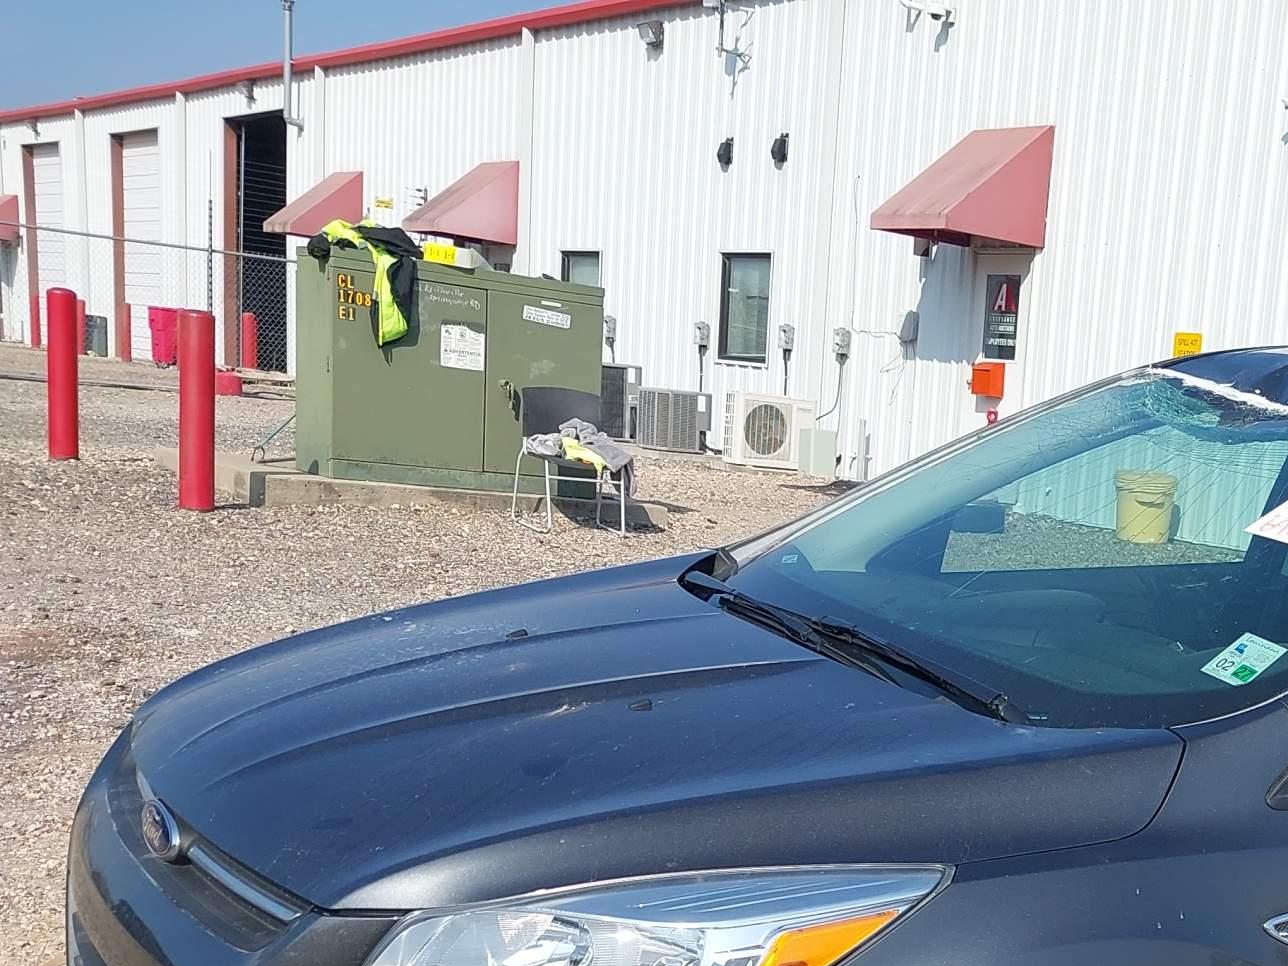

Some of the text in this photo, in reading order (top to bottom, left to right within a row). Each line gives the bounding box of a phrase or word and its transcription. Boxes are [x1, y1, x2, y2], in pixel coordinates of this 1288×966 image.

[338, 274, 354, 289] CL
[338, 289, 372, 306] 1708
[338, 306, 355, 321] E1
[1215, 658, 1235, 671] 02
